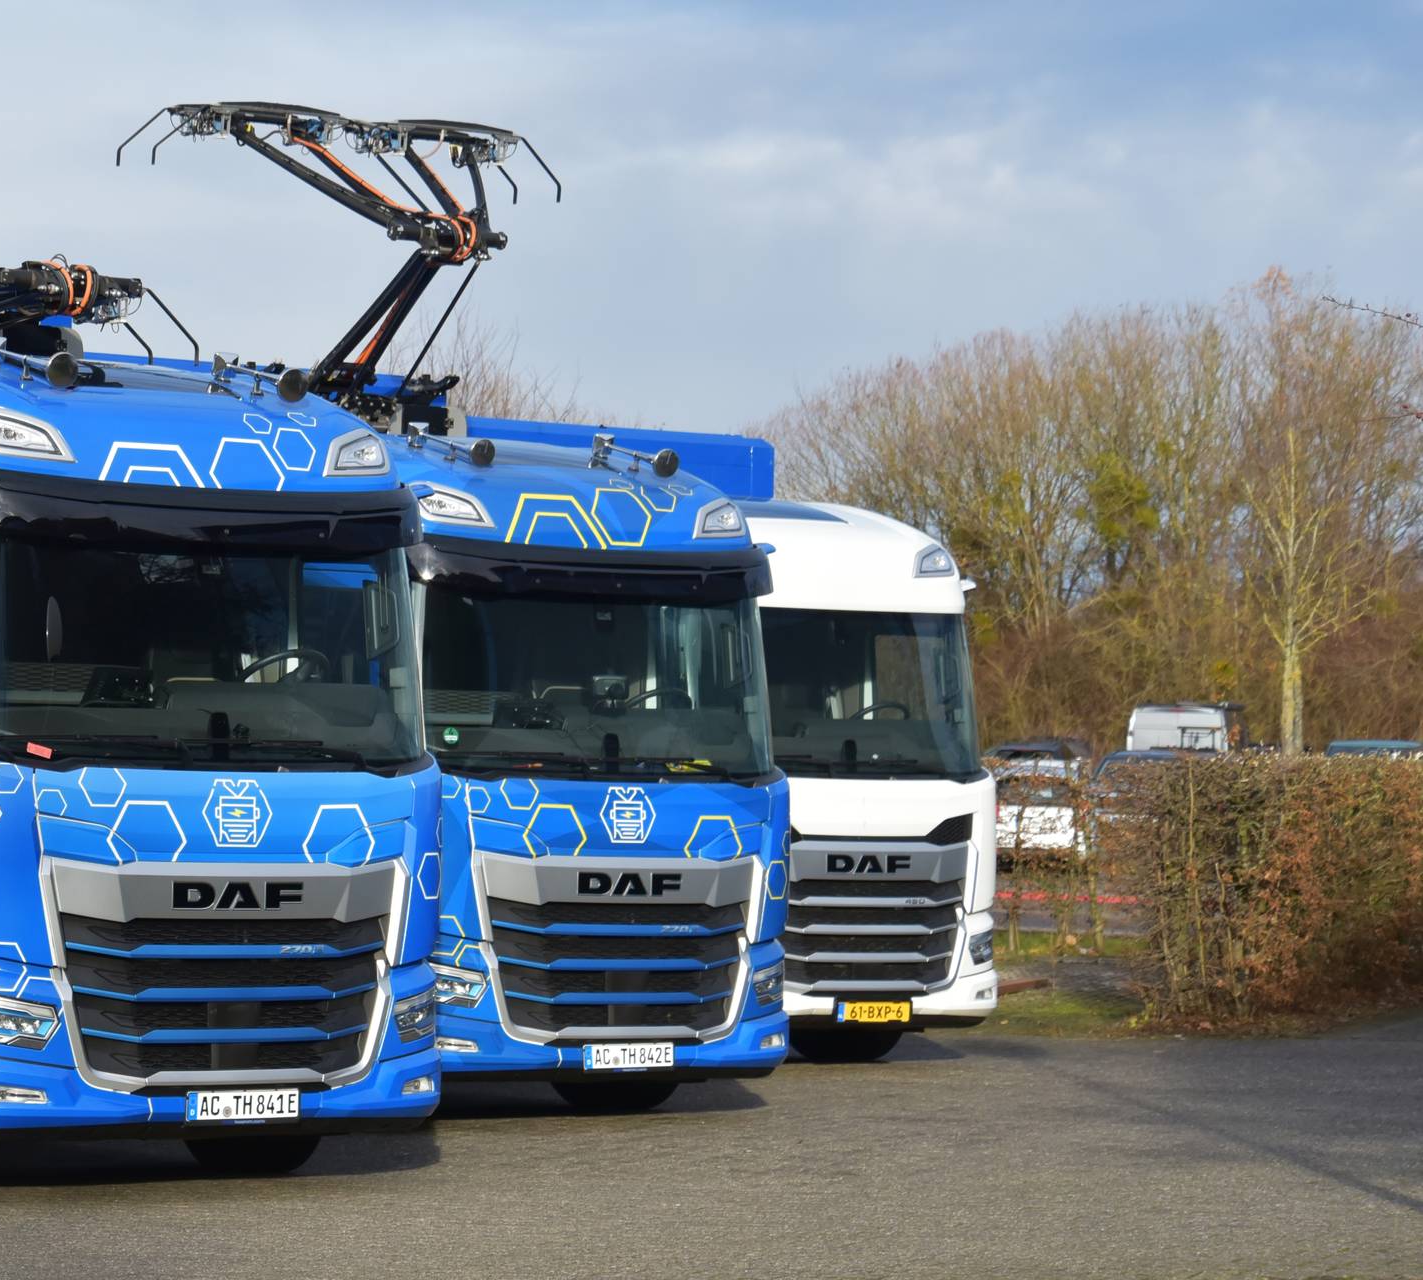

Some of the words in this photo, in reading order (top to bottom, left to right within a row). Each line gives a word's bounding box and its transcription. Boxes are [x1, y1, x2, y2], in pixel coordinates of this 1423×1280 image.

[826, 853, 911, 874] DAF
[577, 871, 682, 896] DAF
[172, 881, 304, 910] DAF
[850, 1006, 904, 1019] 61-BXP-6
[595, 1048, 610, 1065] AC
[200, 1096, 220, 1116] AC
[233, 1095, 252, 1115] TH
[257, 1094, 297, 1114] 841E
